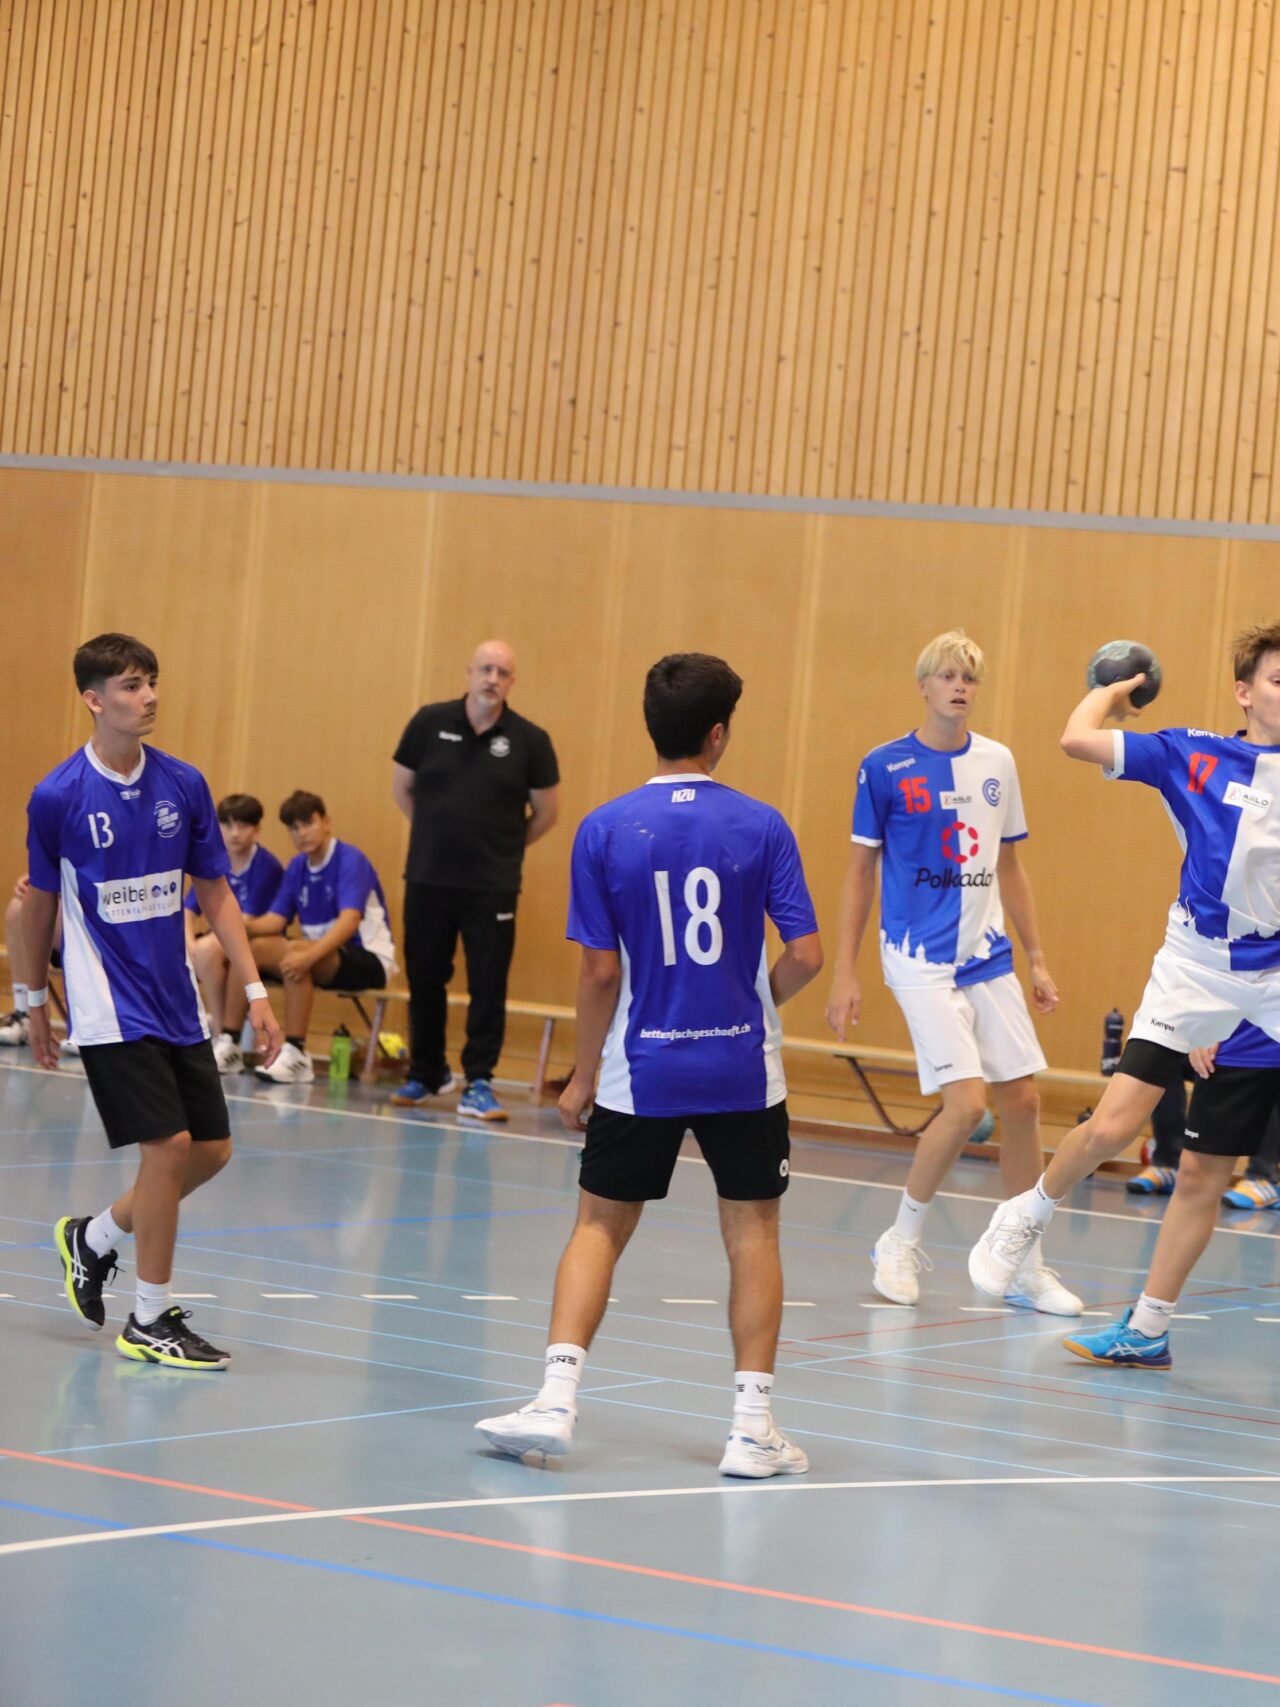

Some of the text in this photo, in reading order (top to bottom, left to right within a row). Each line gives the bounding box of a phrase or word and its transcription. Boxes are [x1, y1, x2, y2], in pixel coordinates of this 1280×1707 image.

[1187, 728, 1225, 740] Kemp
[1187, 751, 1219, 795] 17
[898, 777, 932, 813] 15
[88, 811, 115, 849] 13
[914, 866, 993, 889] Polkado
[654, 866, 724, 967] 18
[549, 1355, 578, 1366] ANS
